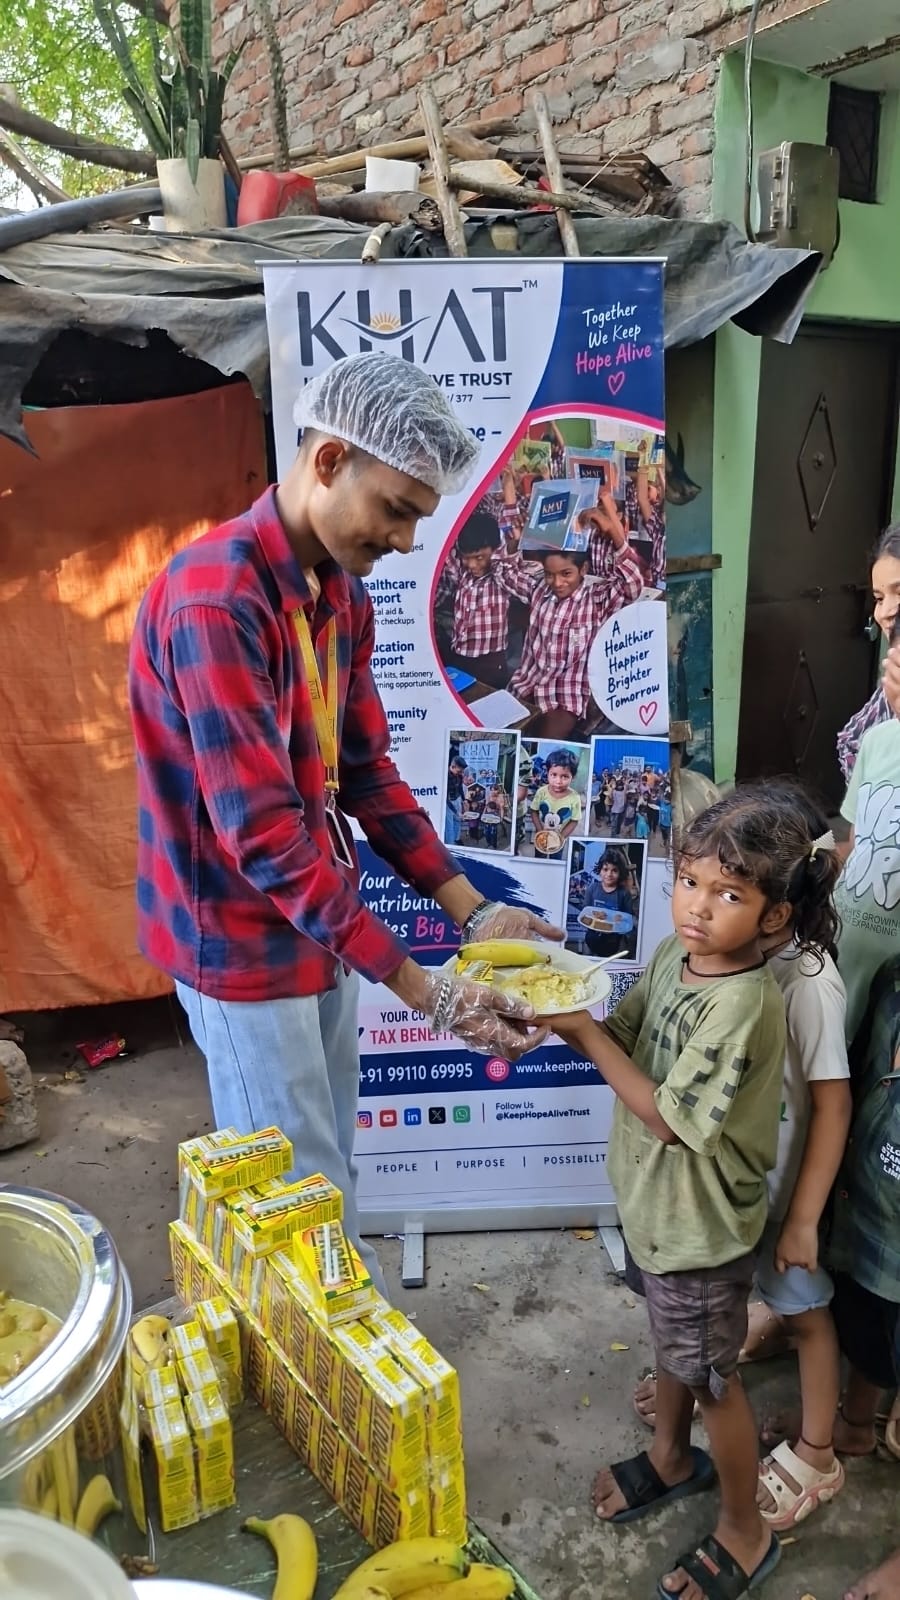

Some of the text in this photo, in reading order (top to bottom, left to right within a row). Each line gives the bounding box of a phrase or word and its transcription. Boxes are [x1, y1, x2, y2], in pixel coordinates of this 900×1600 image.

[582, 301, 638, 328] Together
[297, 287, 522, 366] KHAT
[588, 324, 641, 348] We Keep
[576, 342, 652, 375] Hope Alive
[459, 372, 512, 386] TRUST
[363, 579, 416, 590] ealthcare
[381, 617, 415, 625] checkups
[612, 620, 620, 637] A
[373, 641, 414, 652] ucation
[605, 629, 654, 657] Healthier
[609, 650, 650, 674] Happier
[376, 680, 441, 690] rning opportunities
[608, 668, 652, 693] Brighter
[606, 684, 660, 711] Tomorrow
[387, 707, 427, 720] munity
[415, 915, 445, 943] Big
[862, 912, 900, 929] GROWIN
[380, 1011, 408, 1023] YOUR
[370, 1029, 396, 1044] TAX
[360, 1063, 472, 1083] +91 99110 69995
[515, 1060, 598, 1074] www.keephope
[495, 1101, 534, 1110] Follow Us
[495, 1108, 590, 1121] @KeepHopeAliveTrust
[376, 1153, 606, 1173] PEOPLE PURPOSE POSSIBILIT
